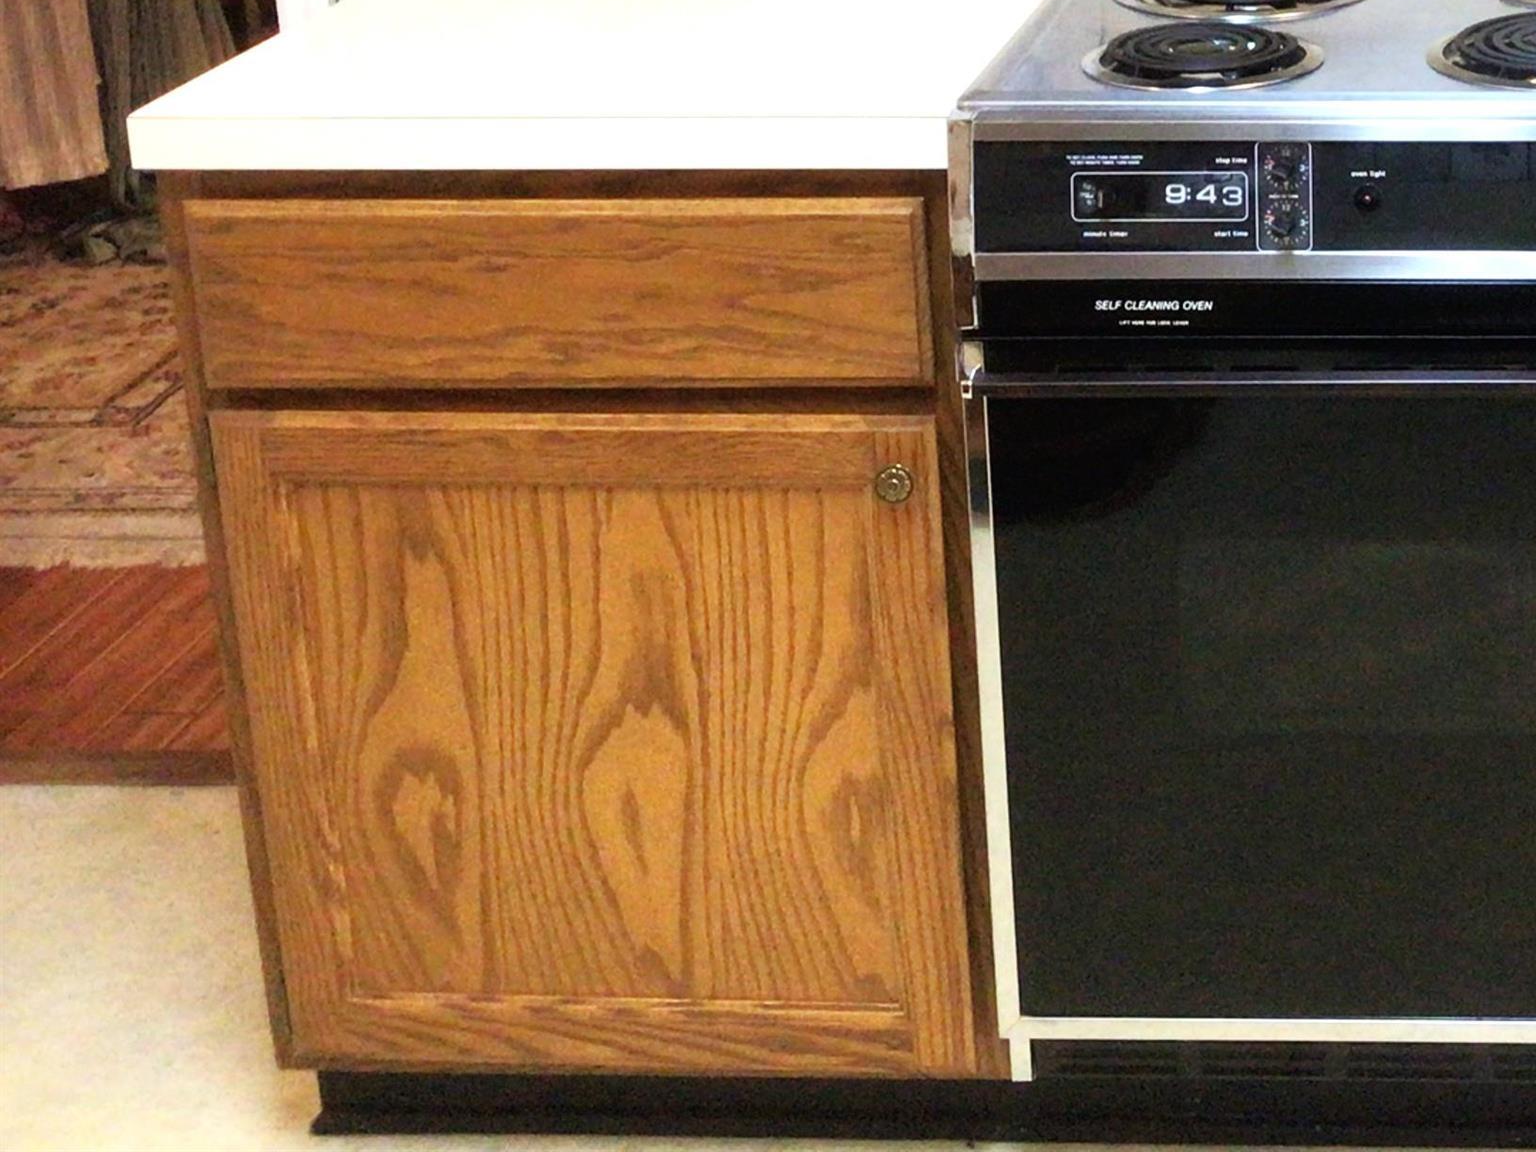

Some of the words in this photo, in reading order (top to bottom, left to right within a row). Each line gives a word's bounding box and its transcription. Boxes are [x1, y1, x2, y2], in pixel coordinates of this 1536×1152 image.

[1215, 156, 1231, 165] stop
[1231, 156, 1248, 164] time
[1369, 169, 1387, 179] light
[1165, 183, 1243, 206] 9:43
[1214, 229, 1231, 238] start
[1233, 230, 1249, 238] time
[1094, 299, 1122, 311] SELF
[1124, 299, 1180, 311] CLEANING
[1182, 299, 1214, 311] OVEN
